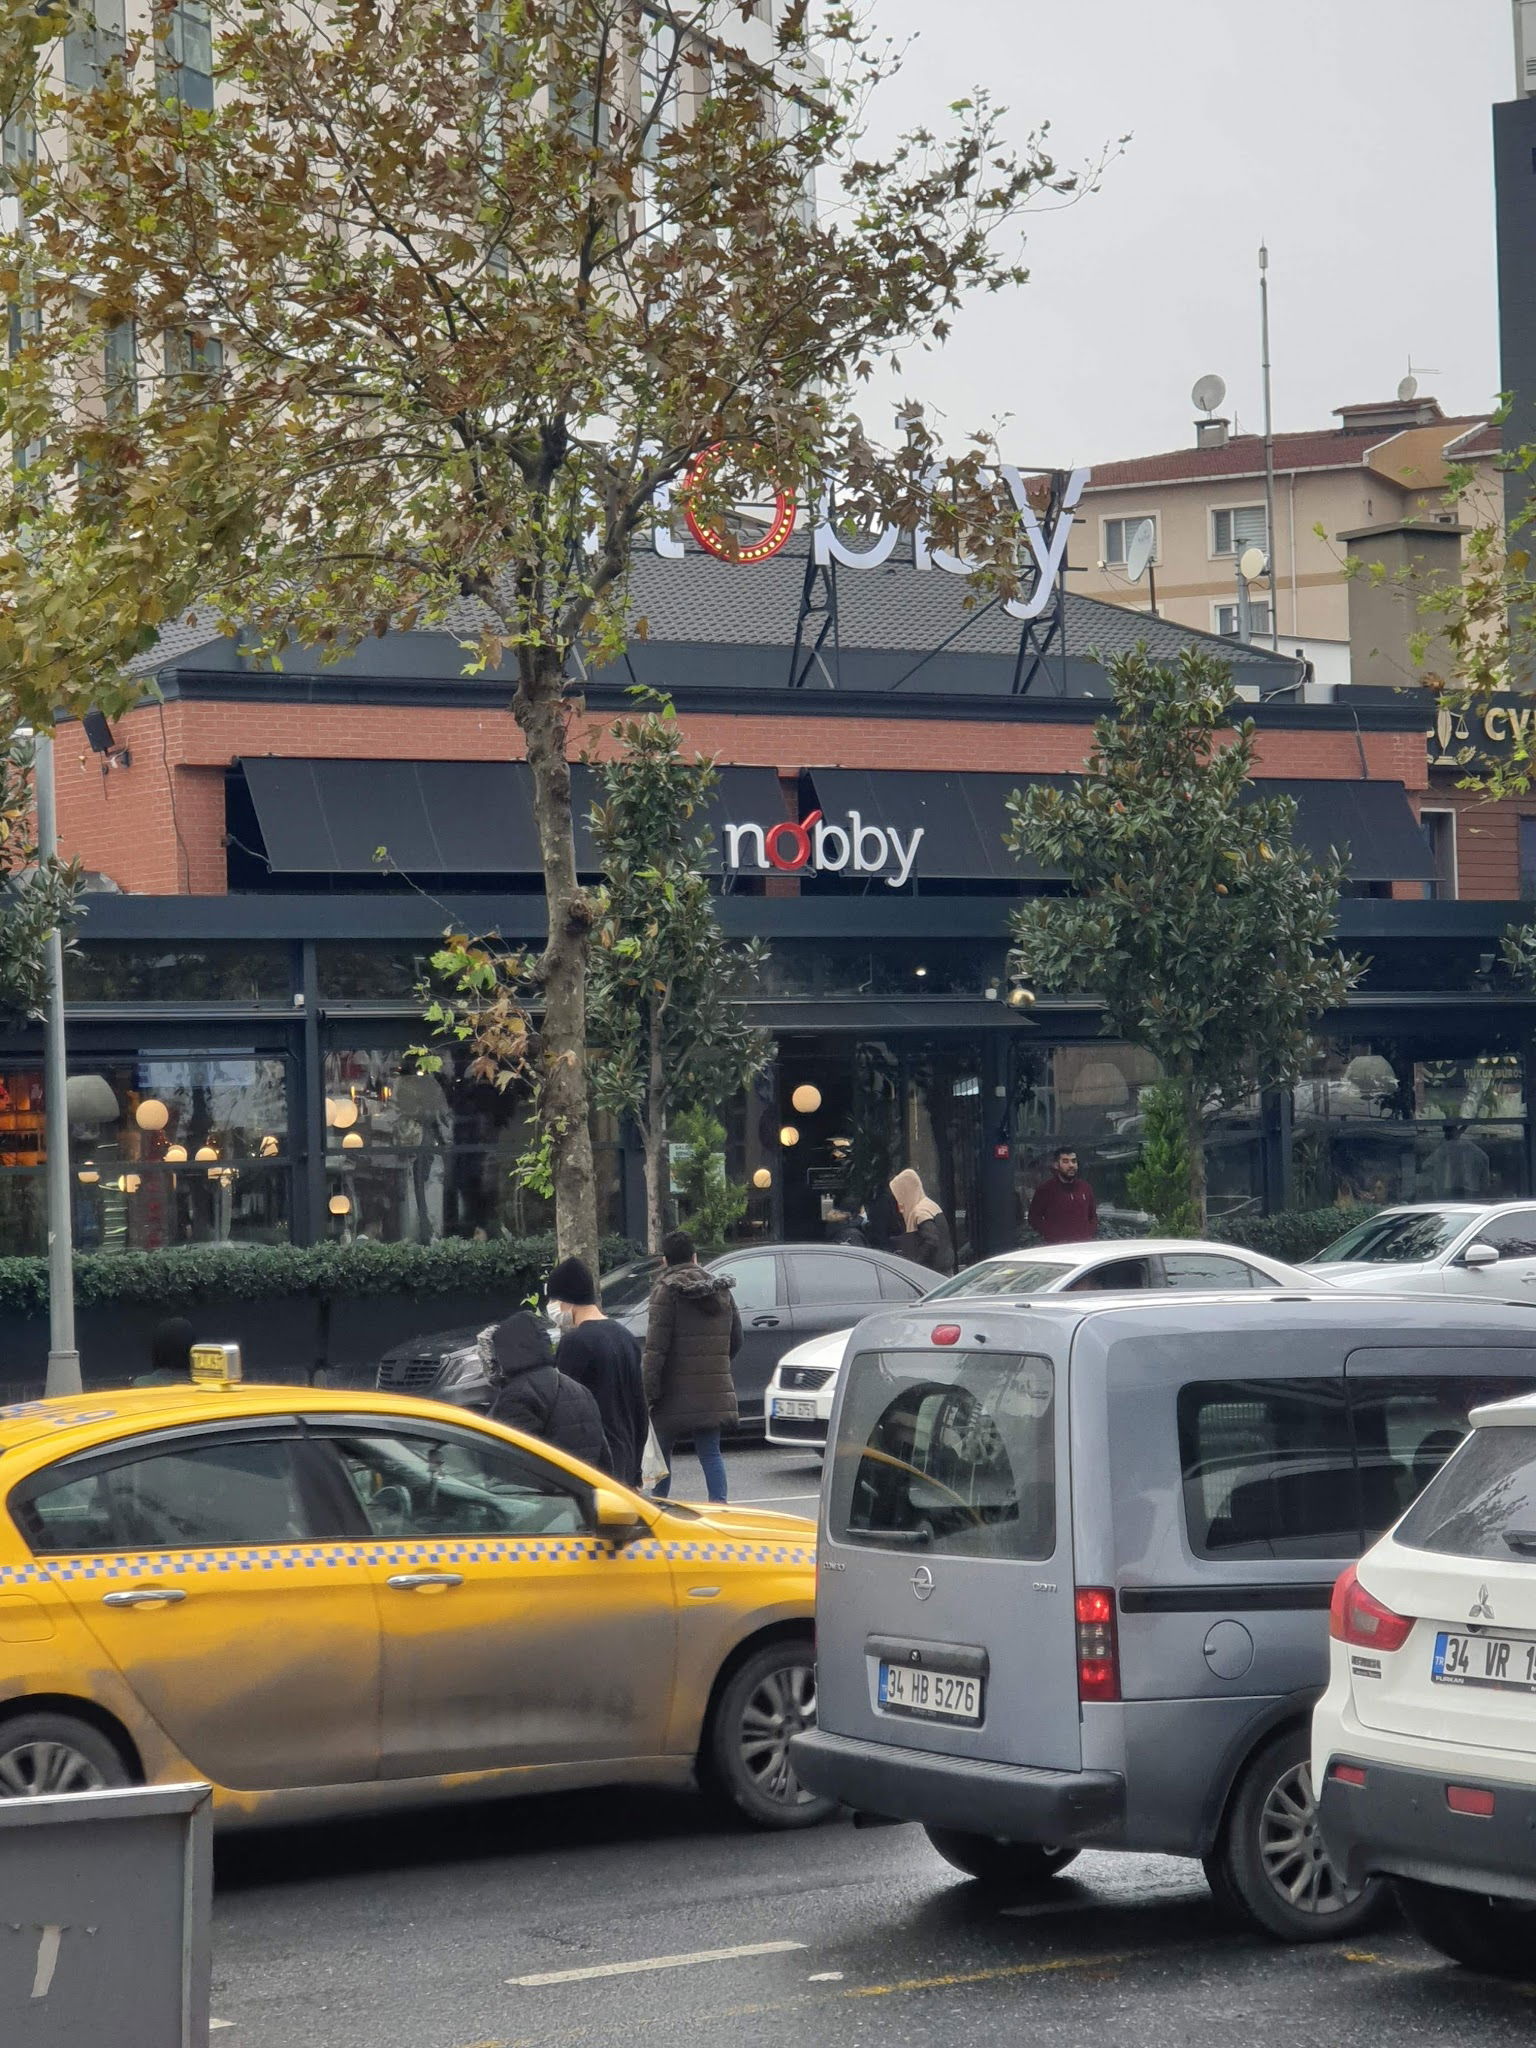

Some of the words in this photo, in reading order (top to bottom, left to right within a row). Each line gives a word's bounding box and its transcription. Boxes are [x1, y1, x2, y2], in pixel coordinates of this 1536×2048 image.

[1484, 707, 1536, 742] CV
[724, 809, 925, 888] nobby
[1446, 1638, 1469, 1673] 34
[1485, 1641, 1511, 1678] VR
[1526, 1646, 1536, 1681] 1
[888, 1669, 904, 1700] 34
[911, 1672, 929, 1704] HB
[935, 1677, 975, 1712] 5276
